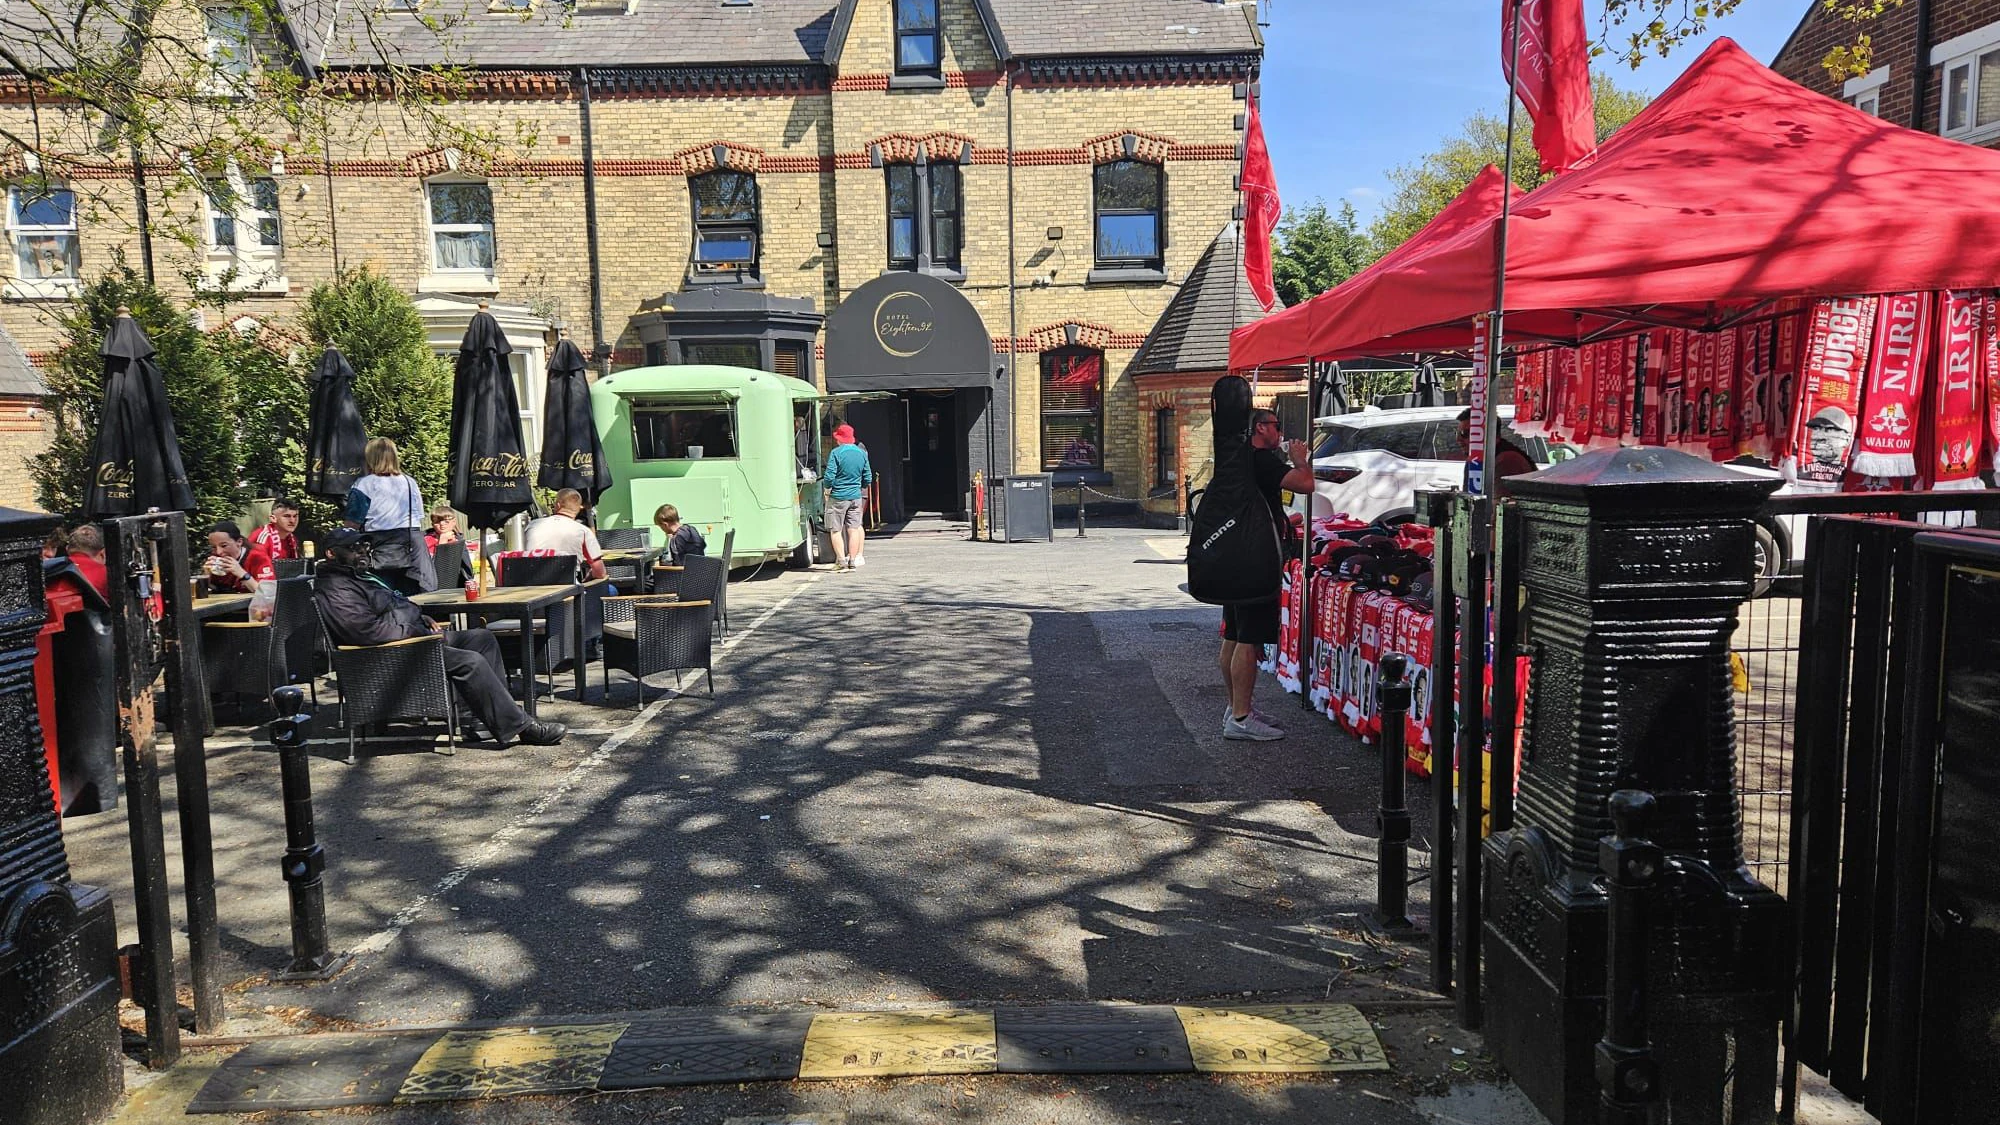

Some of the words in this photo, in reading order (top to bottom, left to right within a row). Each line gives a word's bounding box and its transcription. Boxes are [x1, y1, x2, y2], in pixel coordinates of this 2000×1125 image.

[1807, 375, 1820, 392] HE
[1816, 310, 1830, 328] HE
[1986, 324, 1999, 377] THANKS
[1865, 437, 1895, 449] WALK
[1896, 438, 1911, 449] ON
[1202, 519, 1236, 550] mono
